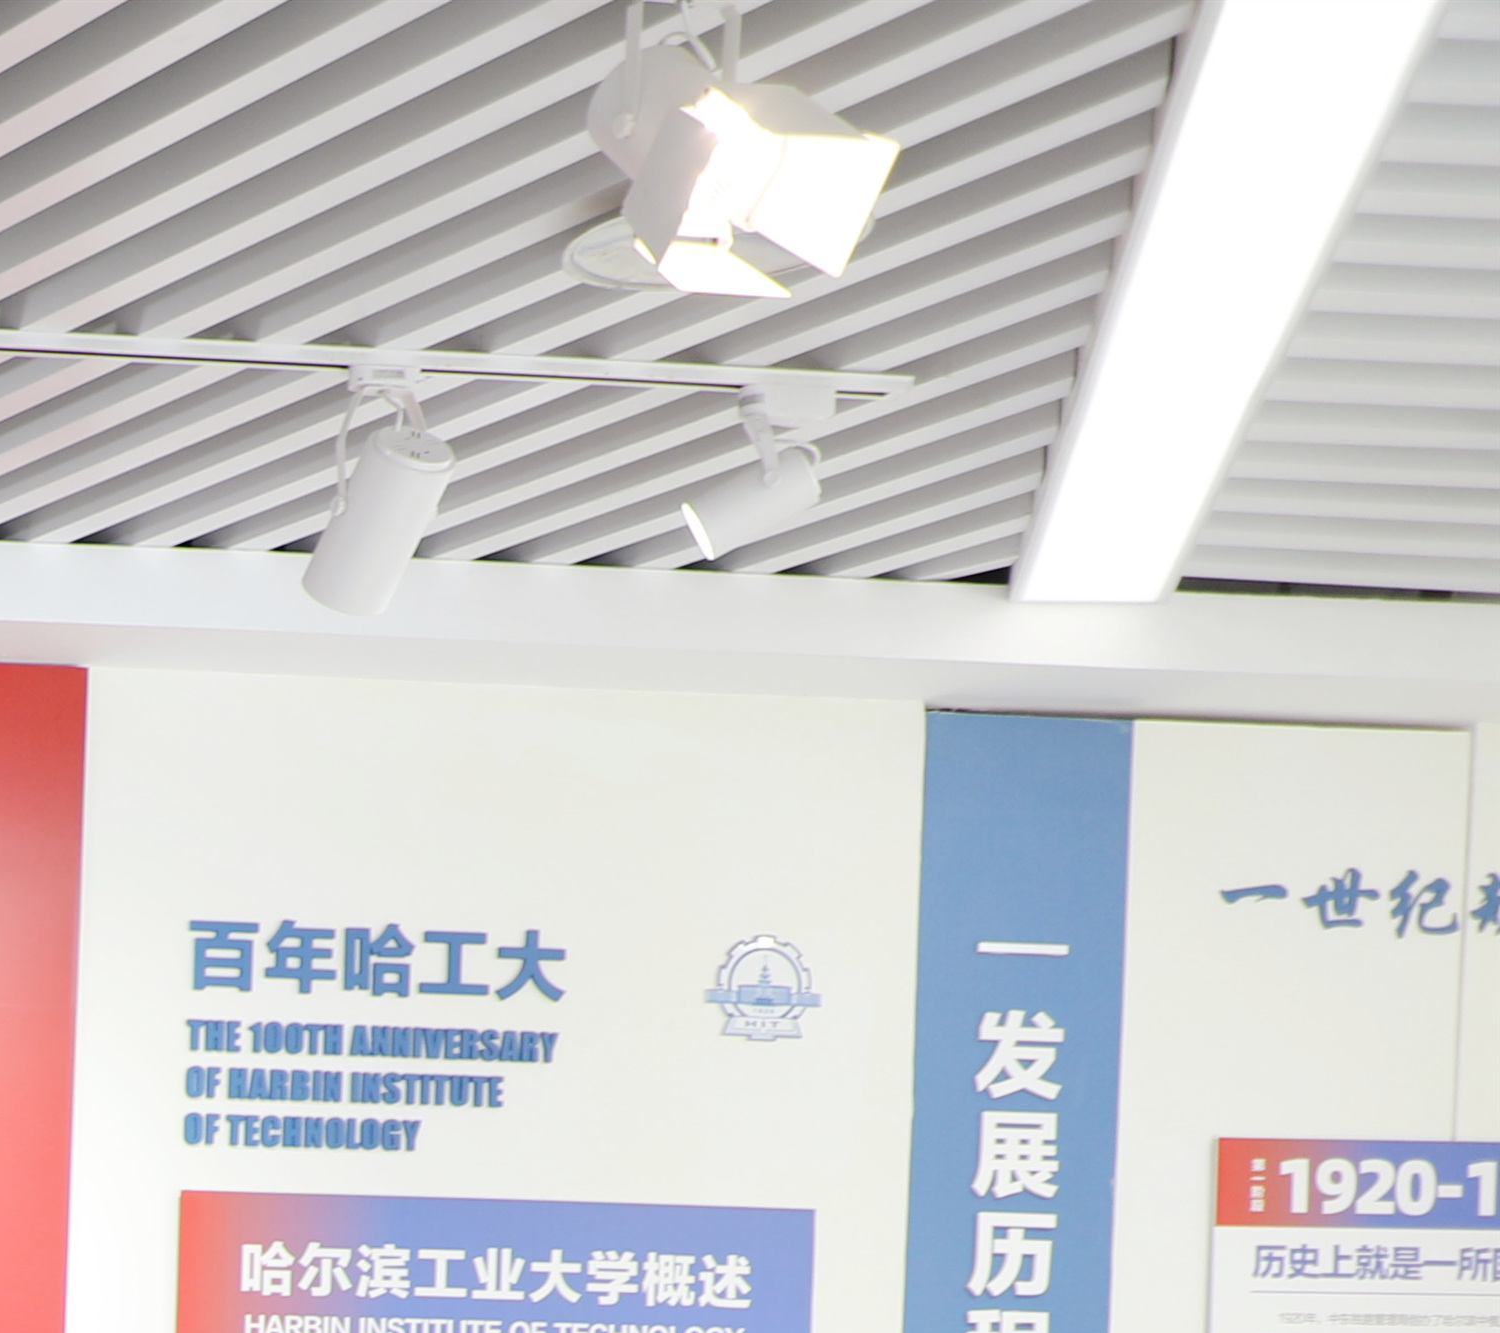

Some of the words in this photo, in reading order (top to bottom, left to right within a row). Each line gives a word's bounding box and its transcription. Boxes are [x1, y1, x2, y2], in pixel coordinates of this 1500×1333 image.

[188, 920, 567, 1002] 百年哈工大
[187, 1019, 242, 1053] THE
[248, 1022, 345, 1057] 100TH
[350, 1026, 559, 1063] ANNIVERSARY
[185, 1065, 222, 1098] OF
[227, 1067, 343, 1102] HARBIN
[351, 1072, 505, 1108] INSTITUTE
[183, 1112, 221, 1146] OF
[226, 1114, 422, 1151] TECHNOLOGY
[1279, 1157, 1498, 1218] 1920-1
[239, 1240, 753, 1310] 哈尔滨工业大学概述
[1252, 1244, 1500, 1282] 历史上就是一所
